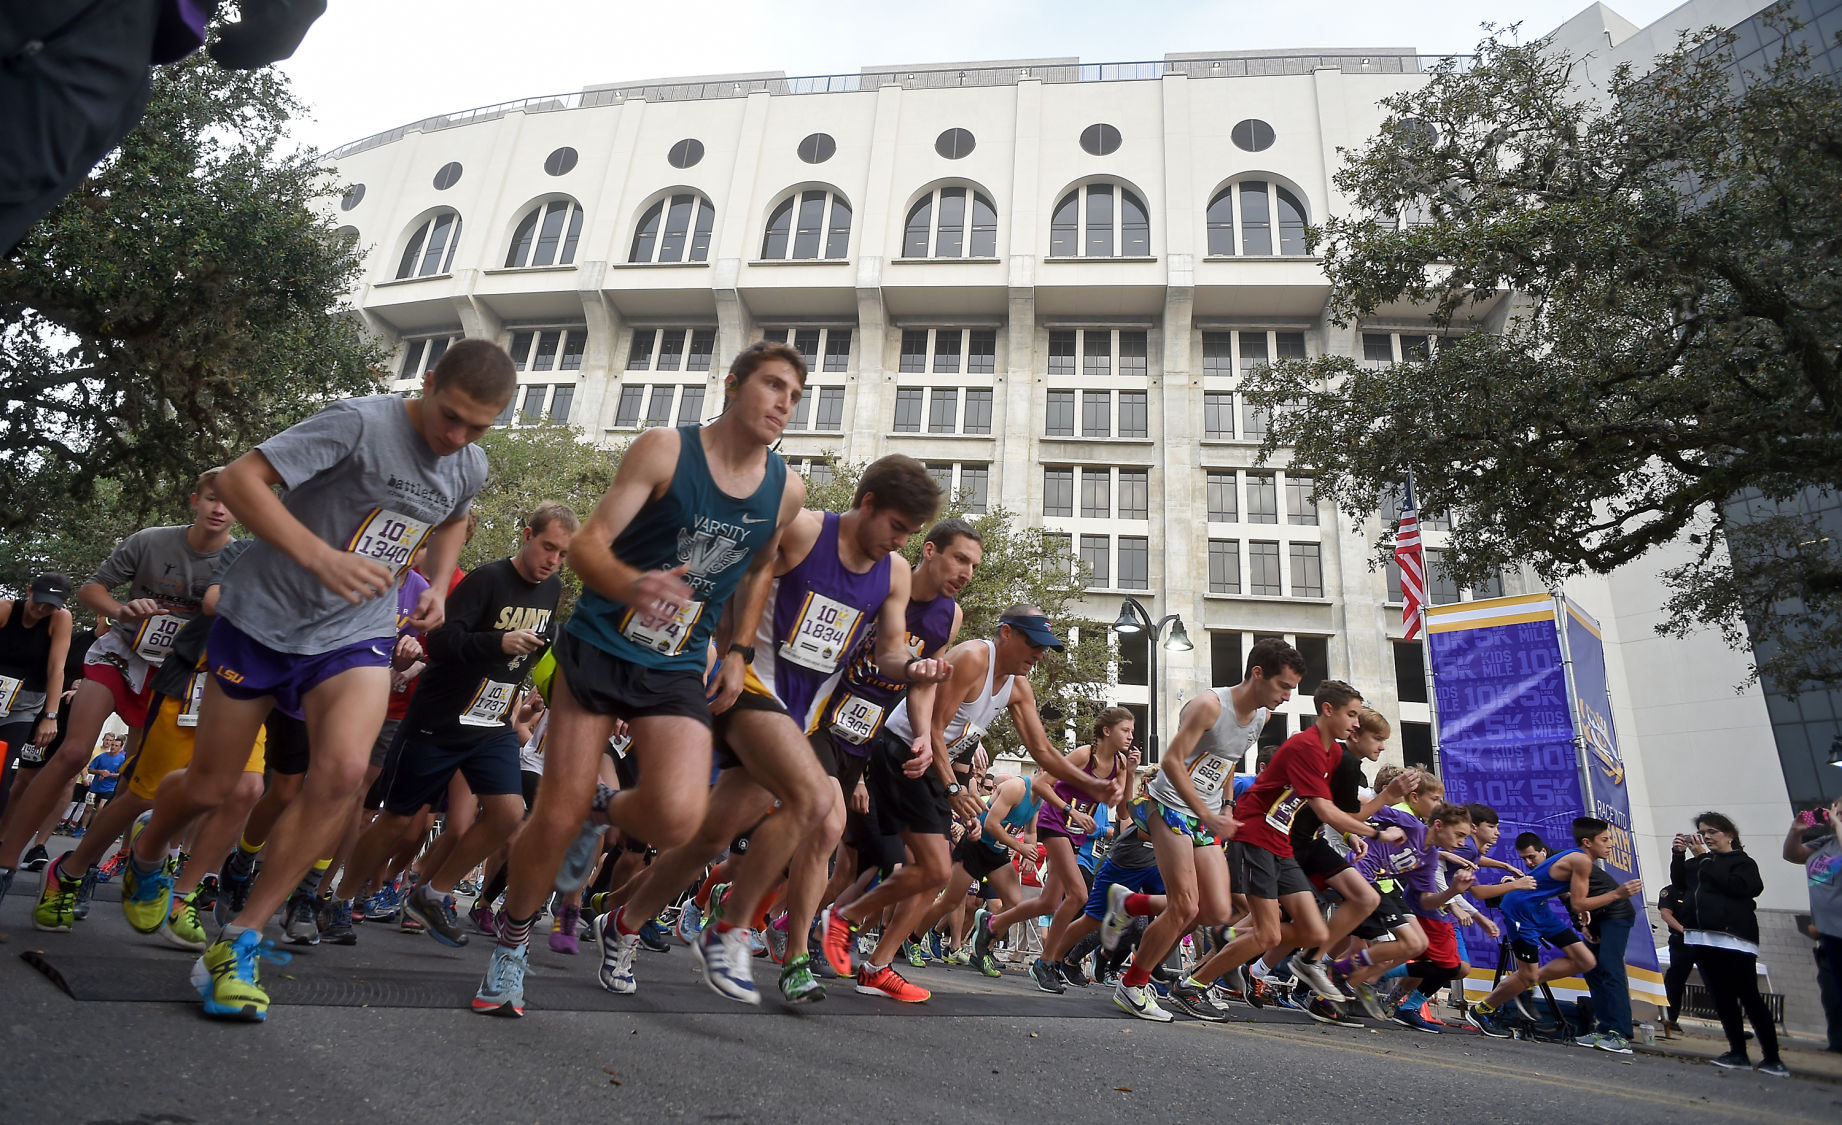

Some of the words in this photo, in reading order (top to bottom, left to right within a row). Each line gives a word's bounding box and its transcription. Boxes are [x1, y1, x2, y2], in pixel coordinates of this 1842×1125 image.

[693, 514, 751, 542] VARSITY
[359, 536, 409, 563] 1340
[640, 615, 681, 637] 974
[802, 619, 844, 645] 1834
[149, 633, 174, 648] 60
[216, 666, 245, 684] LSU
[475, 697, 507, 713] 1737
[839, 712, 871, 736] 1305
[1484, 714, 1526, 740] 5K
[1531, 711, 1564, 725] KIDS
[1532, 724, 1566, 738] MILE
[1198, 766, 1221, 782] 683
[1492, 757, 1526, 771] MILE
[1473, 779, 1529, 806] 10K
[1530, 778, 1577, 806] 5K
[1597, 800, 1614, 823] RACE
[1615, 808, 1628, 830] INTO
